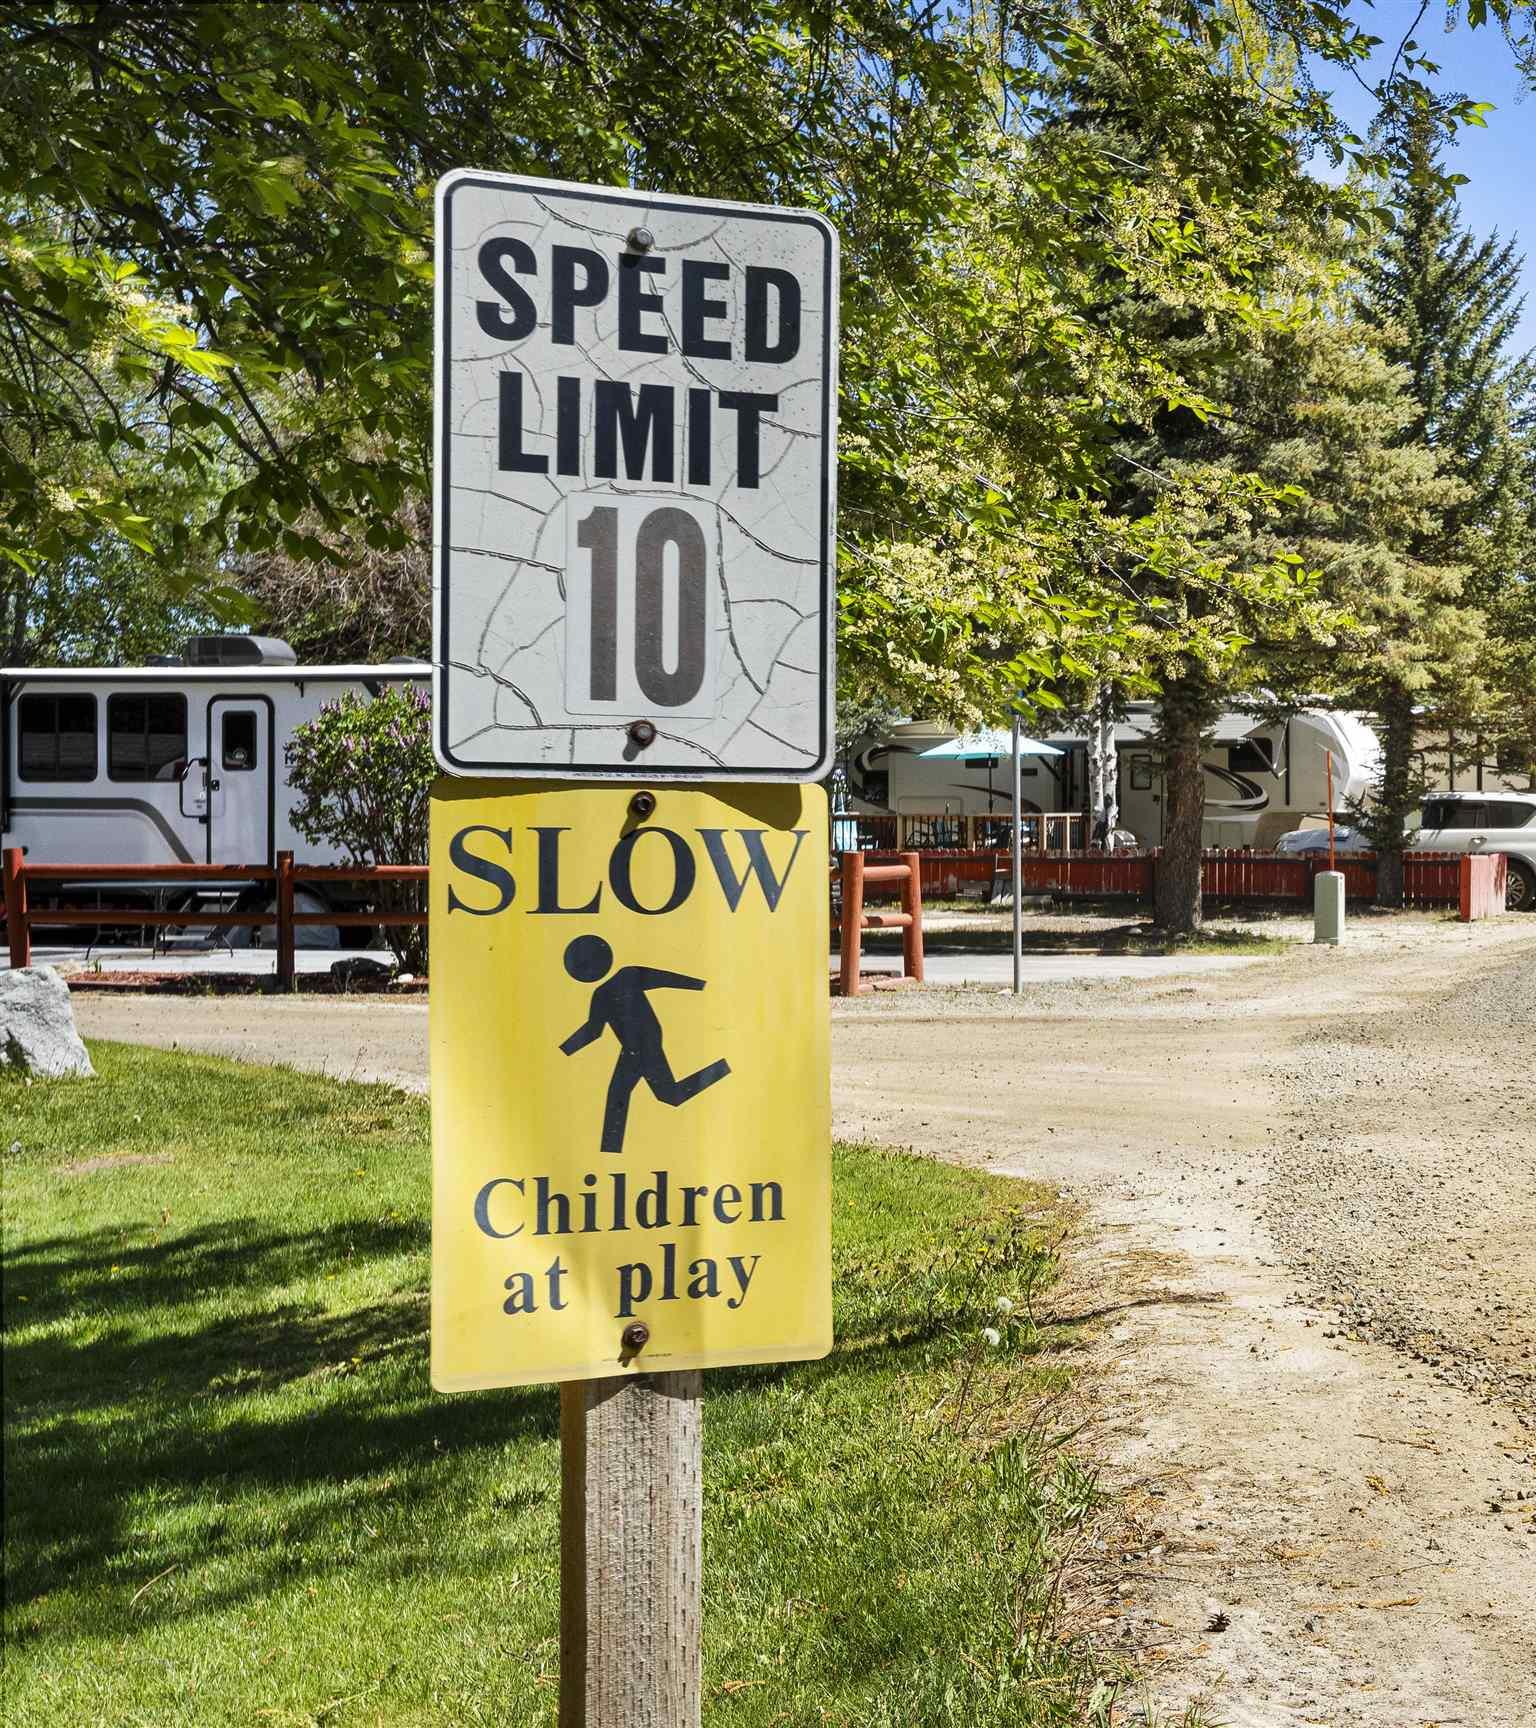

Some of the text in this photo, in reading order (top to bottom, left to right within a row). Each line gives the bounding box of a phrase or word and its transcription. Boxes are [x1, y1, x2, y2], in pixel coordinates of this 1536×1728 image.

[476, 236, 801, 364] SPEED
[498, 371, 779, 489] LIMIT
[576, 505, 707, 708] 10
[447, 825, 810, 916] SLOW
[473, 1170, 785, 1239] Children
[502, 1243, 761, 1318] at play
